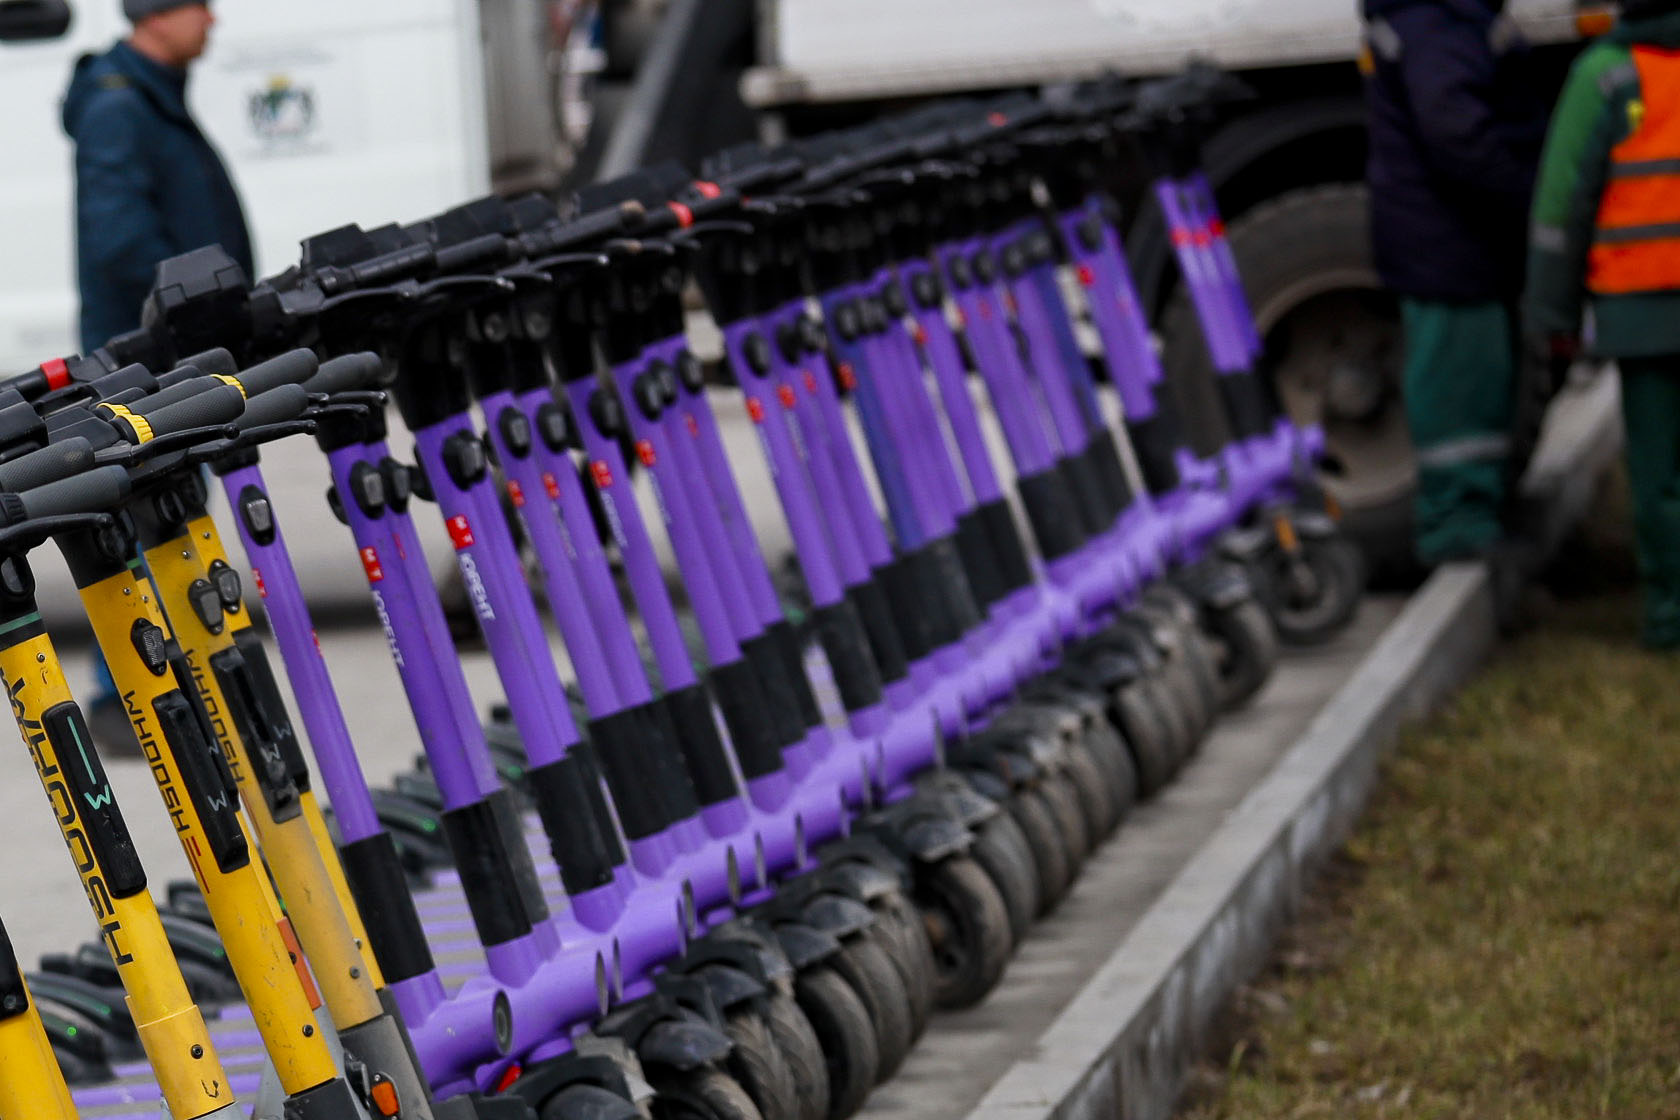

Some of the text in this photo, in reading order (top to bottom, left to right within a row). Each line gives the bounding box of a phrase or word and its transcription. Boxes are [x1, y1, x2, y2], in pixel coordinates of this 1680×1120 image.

[123, 689, 190, 833] WHOOSH
[184, 648, 245, 784] WHOOSH
[11, 677, 134, 967] WHOOSH
[83, 784, 112, 810] W
[208, 790, 228, 812] W
